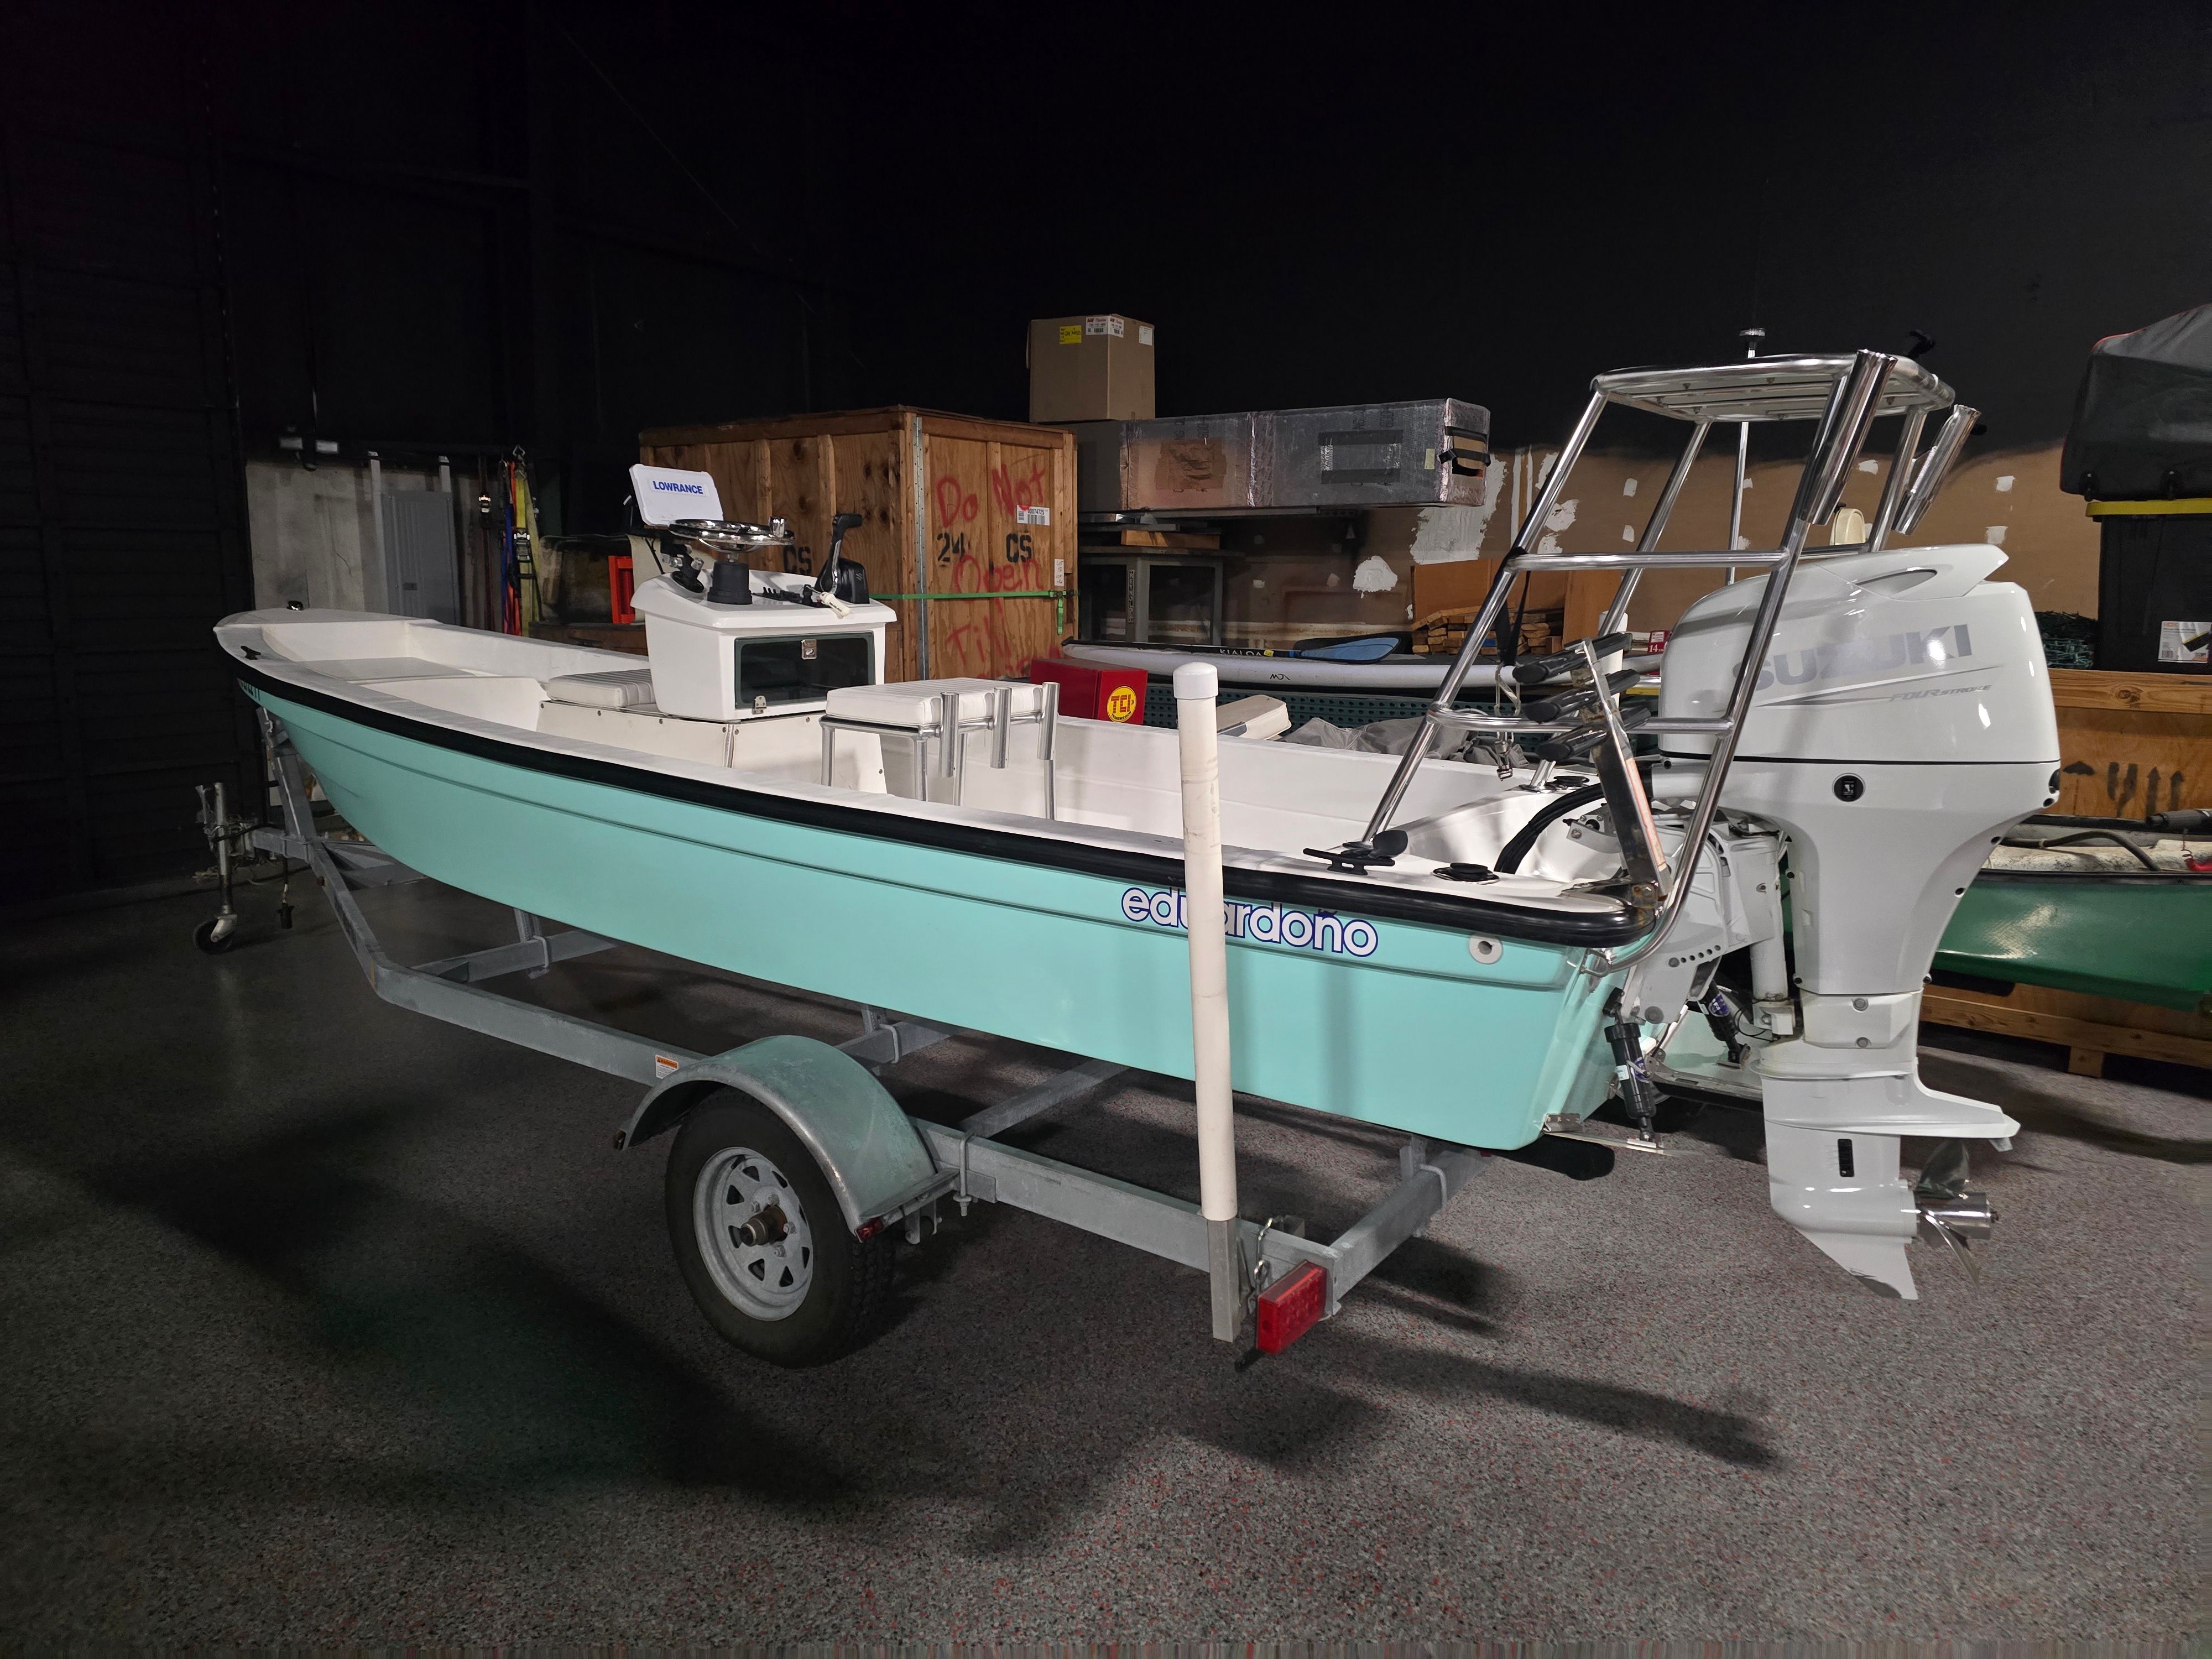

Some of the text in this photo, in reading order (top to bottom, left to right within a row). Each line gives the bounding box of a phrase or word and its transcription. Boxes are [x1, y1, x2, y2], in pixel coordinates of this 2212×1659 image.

[652, 481, 703, 494] LOWRANCE
[936, 463, 1046, 528] Do Not
[952, 554, 1045, 615] Open
[1110, 694, 1131, 713] TCI
